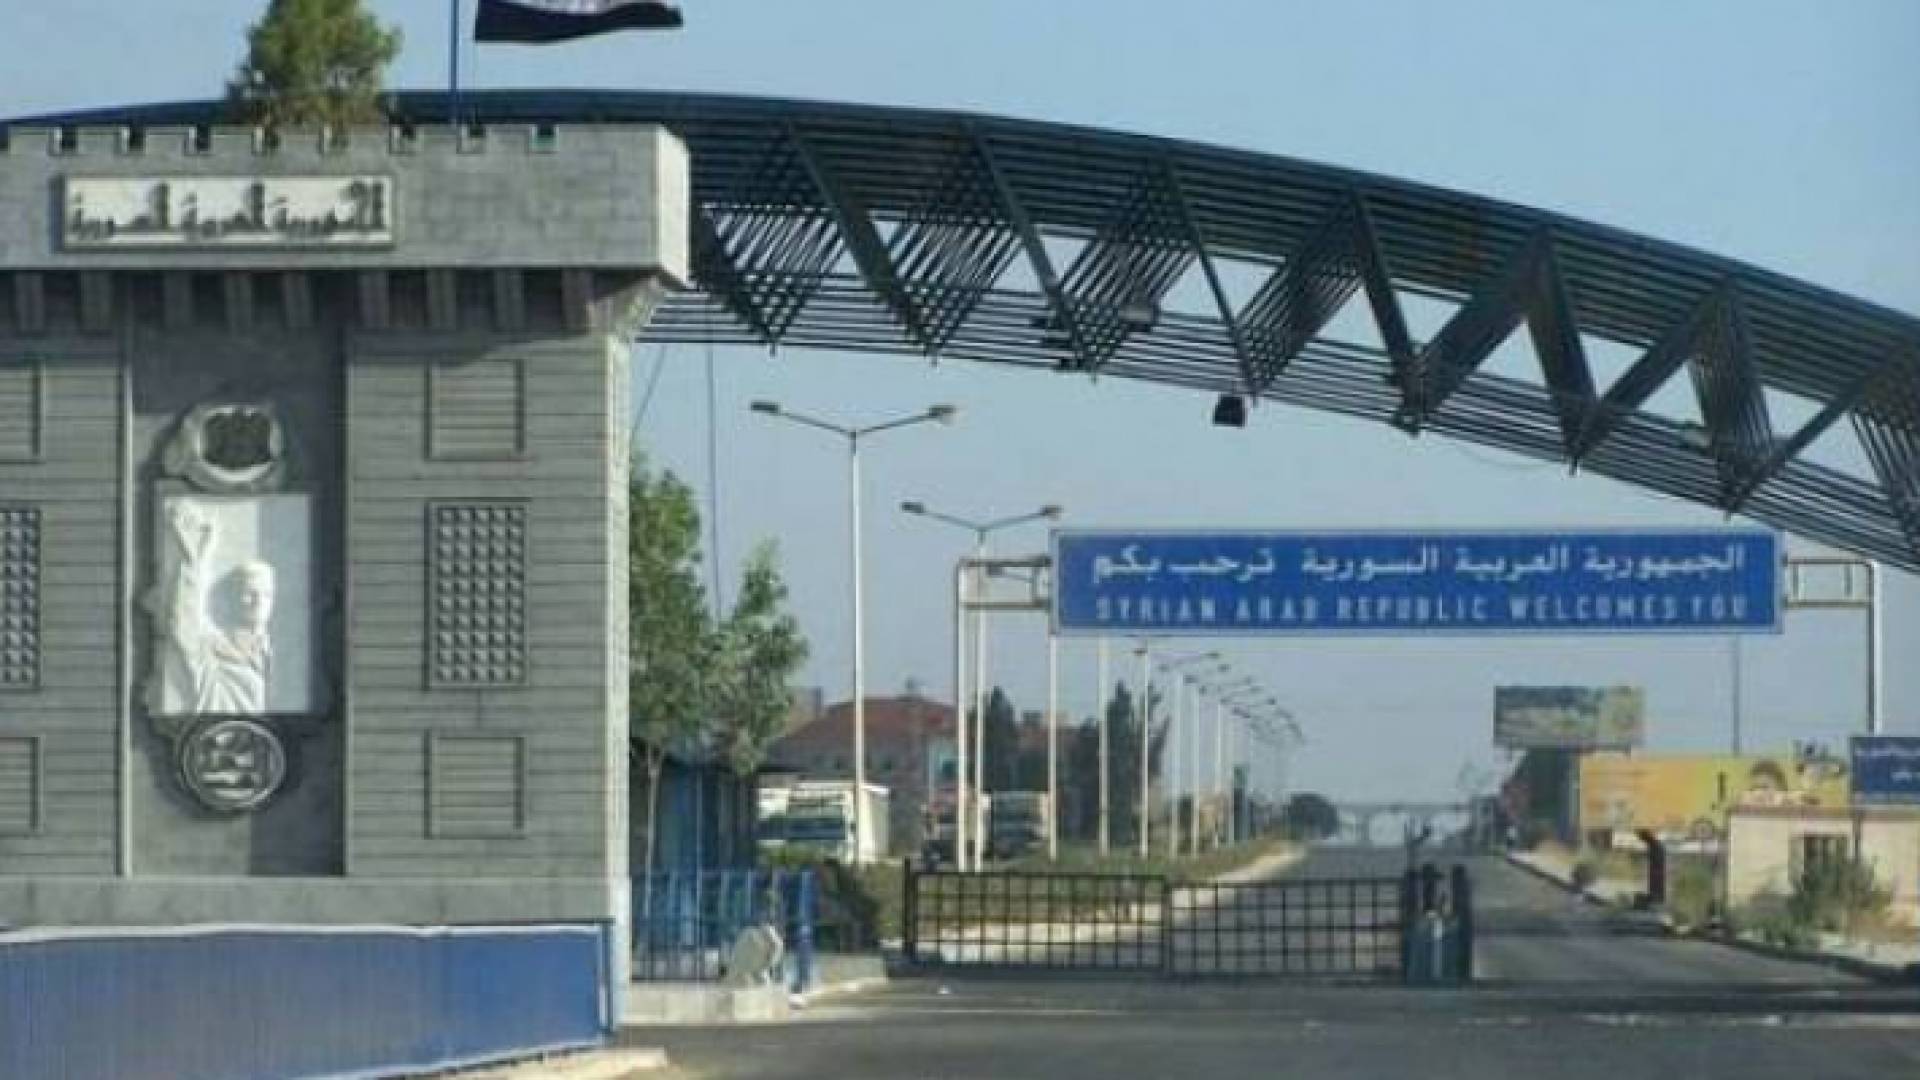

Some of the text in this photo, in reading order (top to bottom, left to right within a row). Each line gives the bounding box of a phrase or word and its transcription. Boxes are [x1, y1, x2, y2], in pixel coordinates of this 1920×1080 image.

[1093, 544, 1745, 584] الجمهورية العربية السورية ترحب بكم
[1095, 596, 1748, 621] SYRIAN ARAB REPUBLIC WELCOMES YOU
